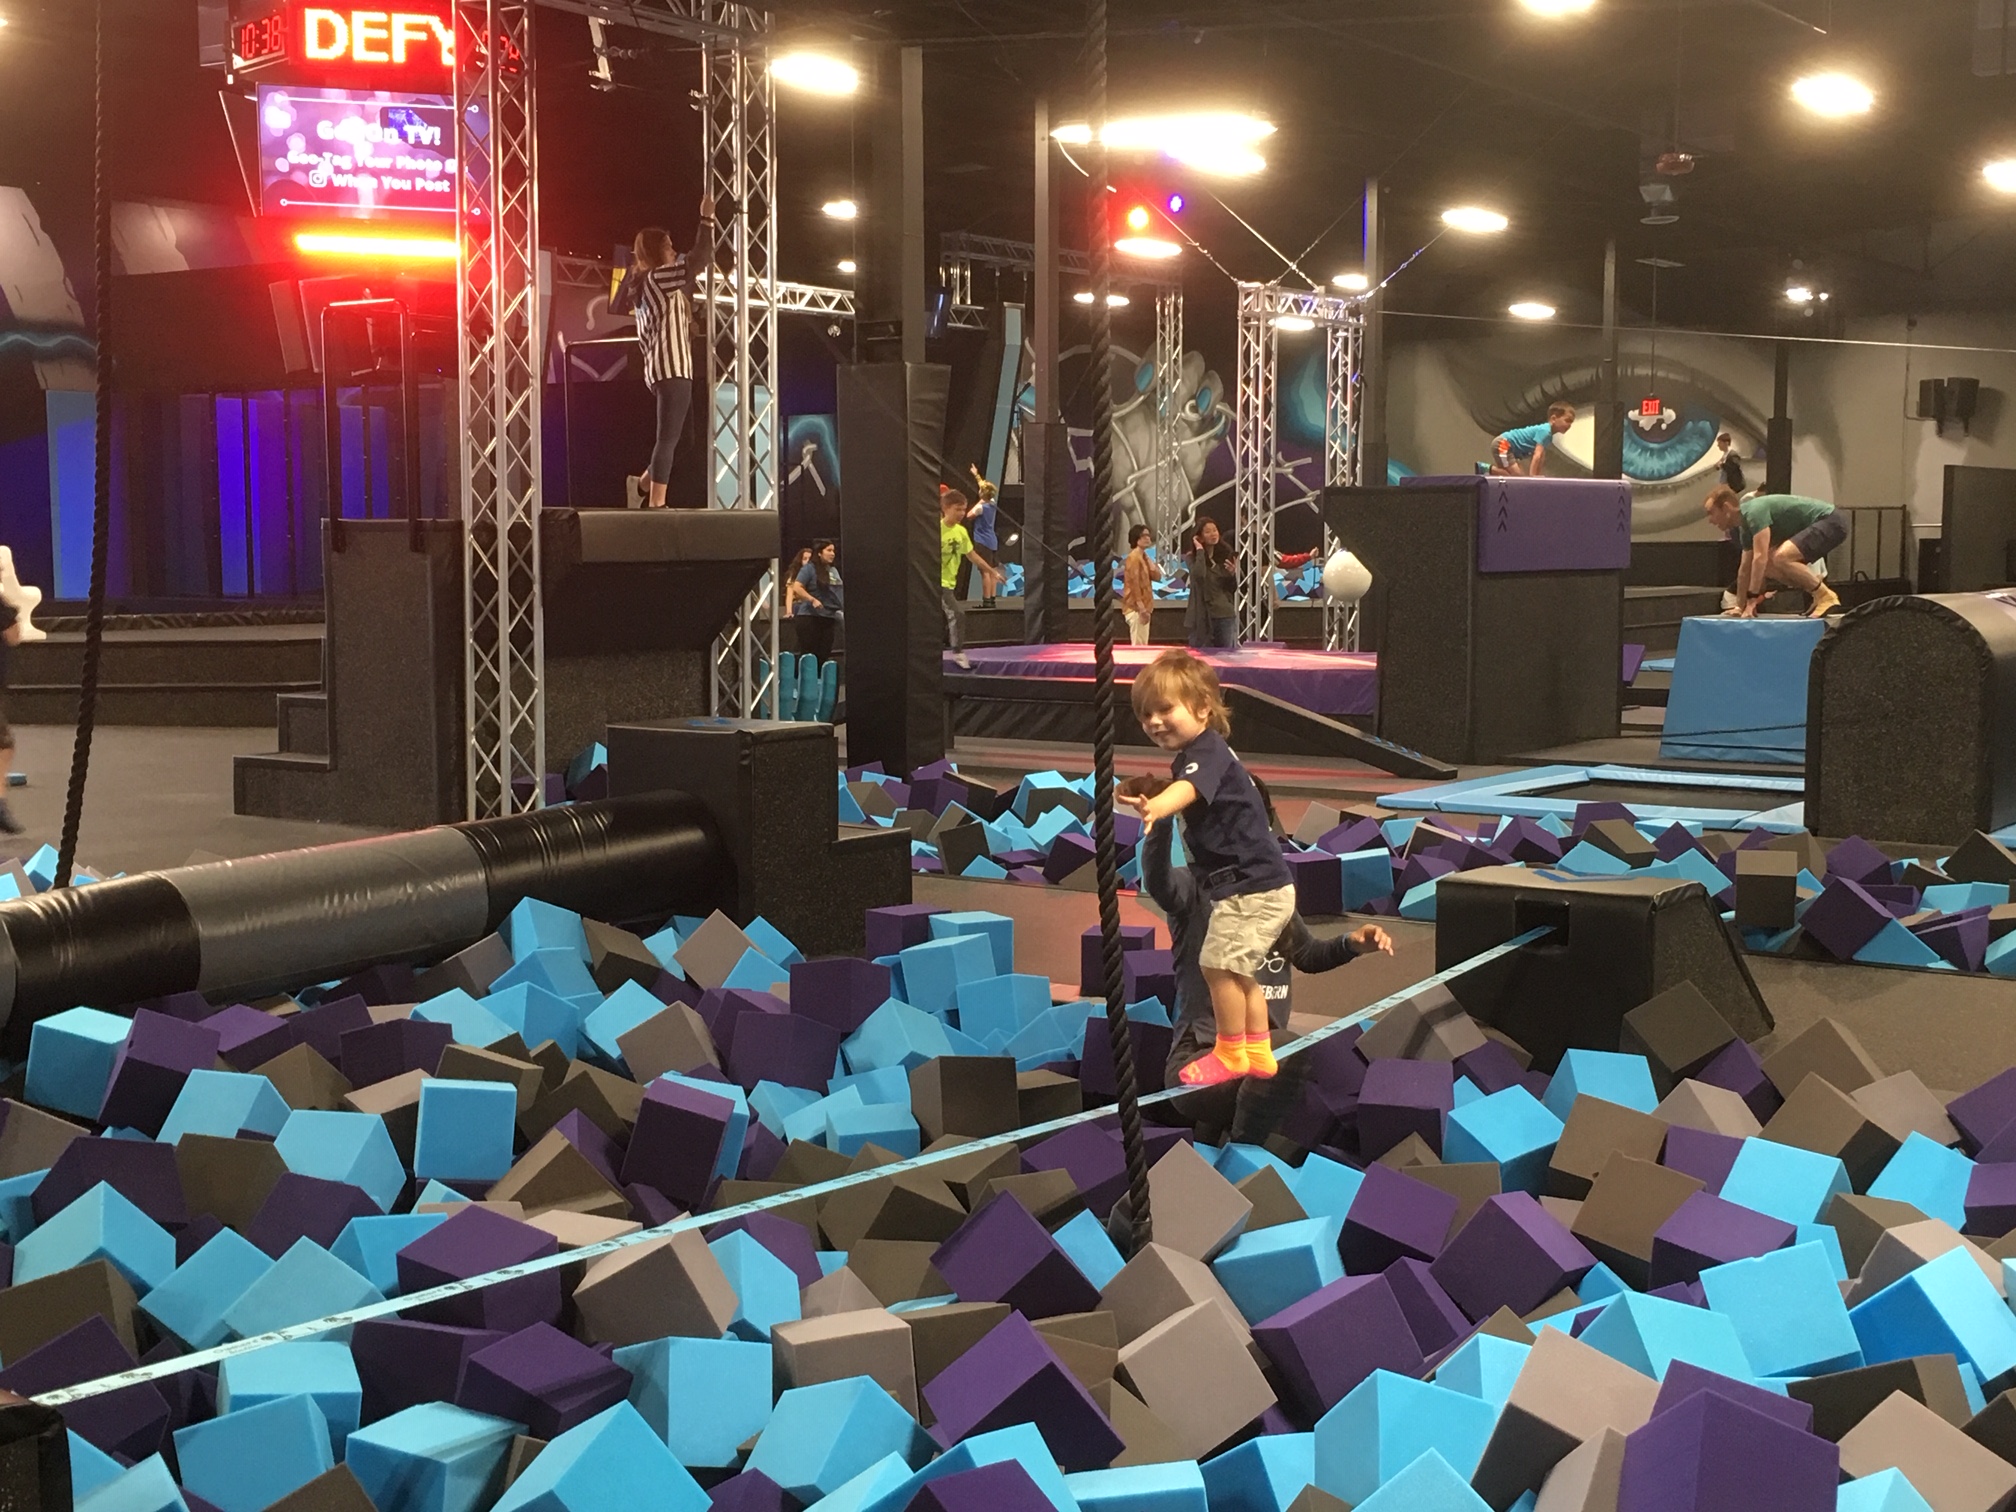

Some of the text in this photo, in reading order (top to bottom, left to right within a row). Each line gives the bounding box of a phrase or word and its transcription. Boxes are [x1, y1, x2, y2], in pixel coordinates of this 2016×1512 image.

[242, 15, 281, 58] 10:38
[304, 8, 456, 66] DEFY
[317, 119, 363, 143] Ge
[403, 125, 441, 146] TV!
[381, 175, 412, 191] You
[415, 178, 450, 192] Post
[1642, 399, 1660, 415] EXIT
